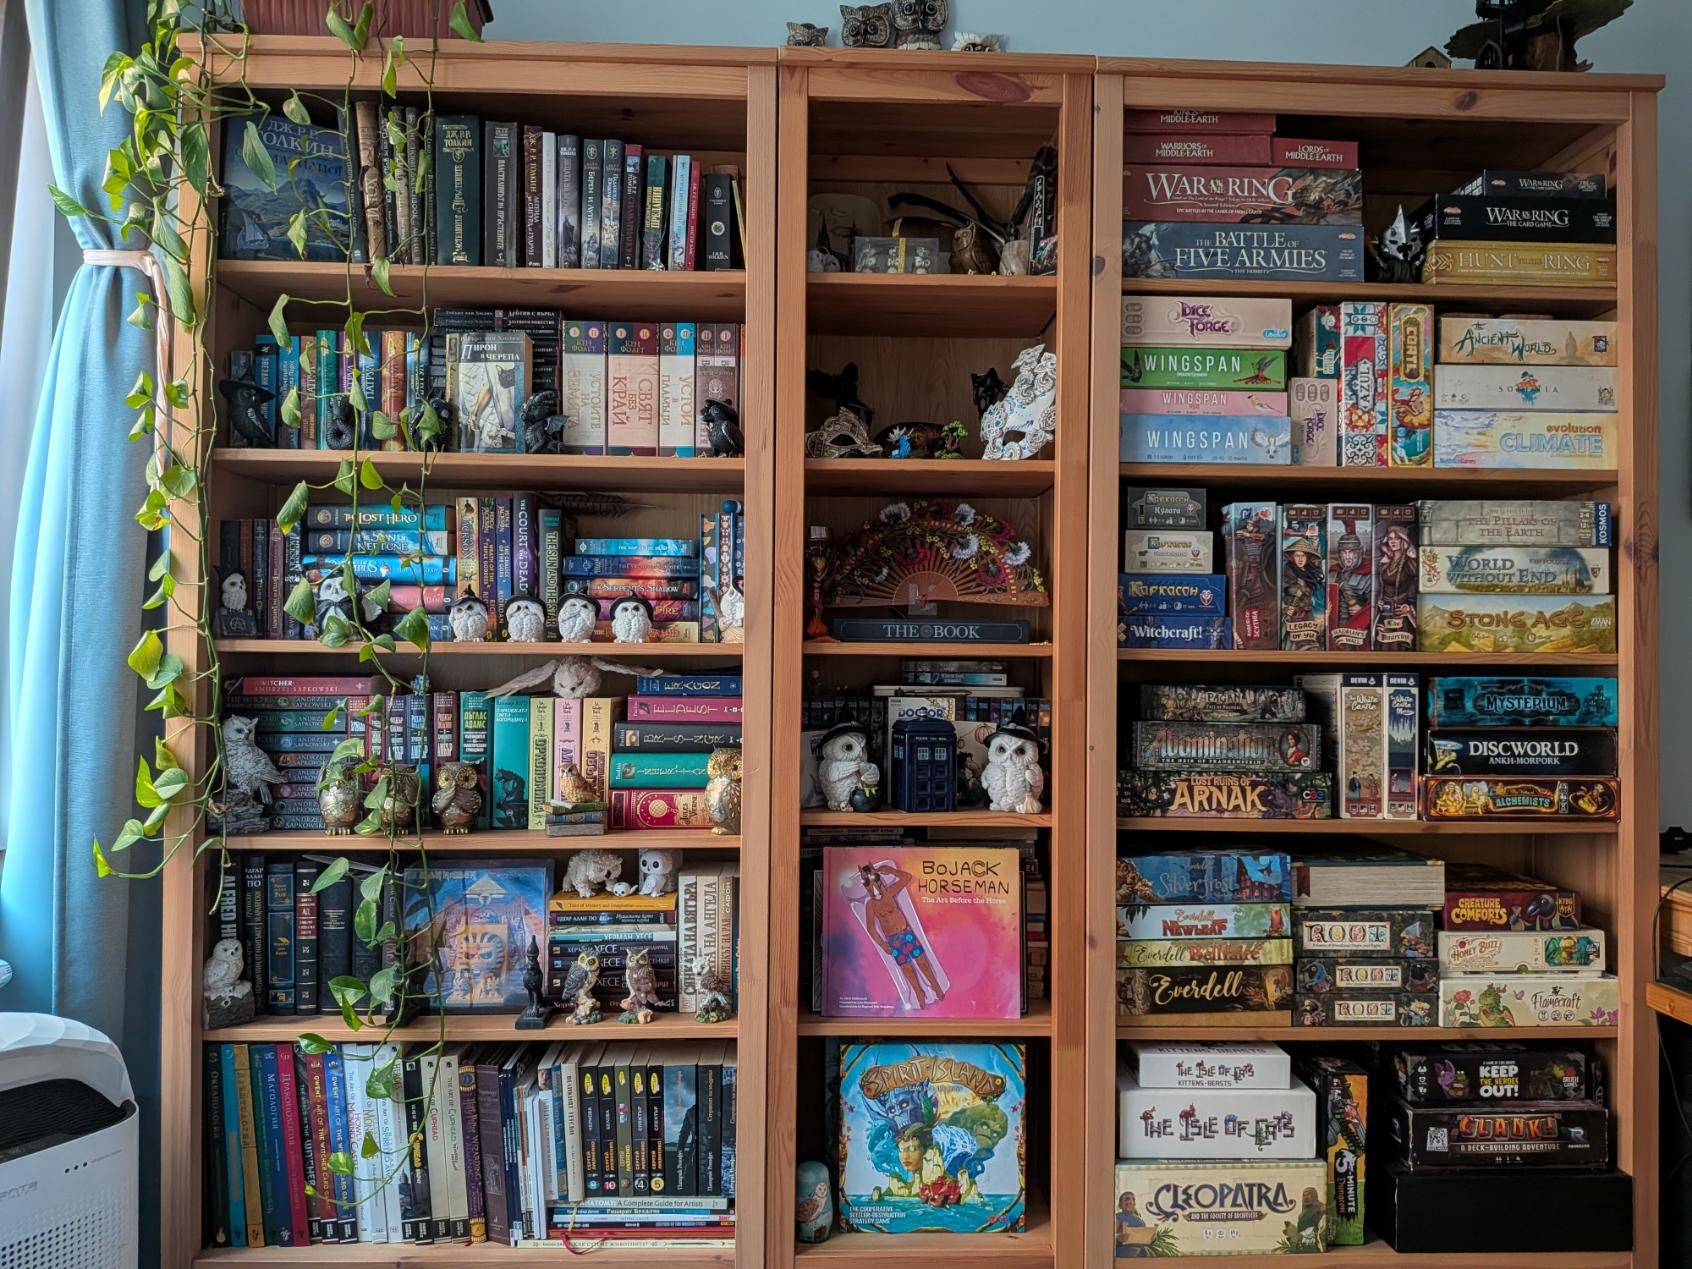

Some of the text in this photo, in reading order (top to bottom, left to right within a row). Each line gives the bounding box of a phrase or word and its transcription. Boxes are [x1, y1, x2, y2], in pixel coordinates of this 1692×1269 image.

[1156, 150, 1213, 158] MIDDLE-EARTH
[1285, 152, 1343, 162] MIDDLE-EARTH
[1145, 173, 1295, 203] WAR RING
[1486, 207, 1569, 225] WAR RING
[1215, 232, 1286, 248] BATTLE
[1175, 248, 1230, 267] FIVE
[1237, 250, 1327, 269] ARMIES
[1458, 253, 1591, 270] HUNT RING
[1176, 301, 1211, 320] DICE
[1186, 317, 1230, 337] FORGE
[1144, 355, 1241, 373] WINGSPAN
[1358, 367, 1370, 404] AZUL
[612, 376, 628, 425] КРАЙ
[628, 393, 637, 410] БЕЗ
[638, 378, 653, 425] СВЯТ
[1162, 392, 1227, 405] WINGSPAN
[1316, 410, 1327, 432] DICE
[1546, 424, 1602, 433] evolution
[1147, 431, 1249, 449] WINGSPAN
[1500, 432, 1603, 453] CLIMATE
[359, 513, 384, 525] LOST
[1494, 516, 1537, 526] PILLARS
[1599, 503, 1607, 544] KOSMOS
[518, 511, 528, 548] COURT
[1480, 528, 1545, 537] THE EARTH
[1446, 555, 1514, 572] WORLD
[519, 562, 528, 591] DEAD
[546, 532, 558, 627] THE SUN AND THE STAR
[1447, 568, 1557, 585] WITHOUT END
[603, 584, 645, 592] SERPENT'S
[656, 606, 679, 615] FIRE
[1446, 610, 1585, 630] STONE AGE
[882, 624, 981, 639] THE BOOK
[1130, 626, 1203, 641] Witchcraft!
[665, 681, 720, 690] ERAGON
[1207, 692, 1244, 704] PAGAN
[1483, 696, 1568, 713] MYSTERIUM
[464, 711, 487, 720] ДЪГЛАС
[653, 703, 719, 714] ELDEST
[464, 721, 486, 729] АДАМС
[644, 733, 725, 744] BRISINGR
[1469, 741, 1579, 757] DISCWORLD
[1488, 757, 1561, 766] ANKH-MORPORK
[1191, 776, 1251, 786] LOST RUINS OF
[689, 795, 698, 817] VERNE
[1169, 785, 1268, 813] ARNAK
[1496, 797, 1550, 807] ALCHEMISTS
[680, 803, 689, 825] JULES
[922, 860, 1002, 878] BoJACK
[918, 879, 1010, 895] HORSEMAN
[1458, 898, 1501, 908] CREATURE
[684, 882, 697, 942] НА ВЯТЪРА
[1451, 907, 1508, 924] COMFORTS
[1162, 919, 1228, 937] NEWLEAF
[1305, 923, 1388, 944] ROOT
[704, 931, 717, 948] НА
[594, 945, 617, 953] ХЕСЕ
[1451, 940, 1499, 961] HONEY BUZZ
[597, 979, 620, 987] ХЕСЕ
[1338, 967, 1399, 983] ROOT
[1150, 971, 1243, 1005] Everdell
[1337, 1002, 1393, 1016] ROOT
[1531, 993, 1583, 1010] Flamecraft
[867, 1058, 995, 1094] SPIRIT ISLAND
[1176, 1060, 1255, 1082] THE ISLE OF CATS
[1479, 1066, 1519, 1078] KEEP
[331, 1076, 339, 1099] GWENT
[1495, 1077, 1519, 1086] HEROES
[1479, 1085, 1519, 1097] OUT!
[430, 1108, 439, 1141] CUPHEAD
[448, 1108, 456, 1143] CUPHEAD
[1139, 1103, 1295, 1151] THE ISLE OF CATS
[1458, 1115, 1554, 1138] CLANK!
[1468, 1143, 1521, 1152] DECK-BUILDING
[1522, 1143, 1561, 1151] ADVENTURE
[604, 1181, 616, 1190] 10
[638, 1180, 644, 1189] 4
[654, 1180, 661, 1188] 5
[1145, 1182, 1297, 1223] CLEOPATRA
